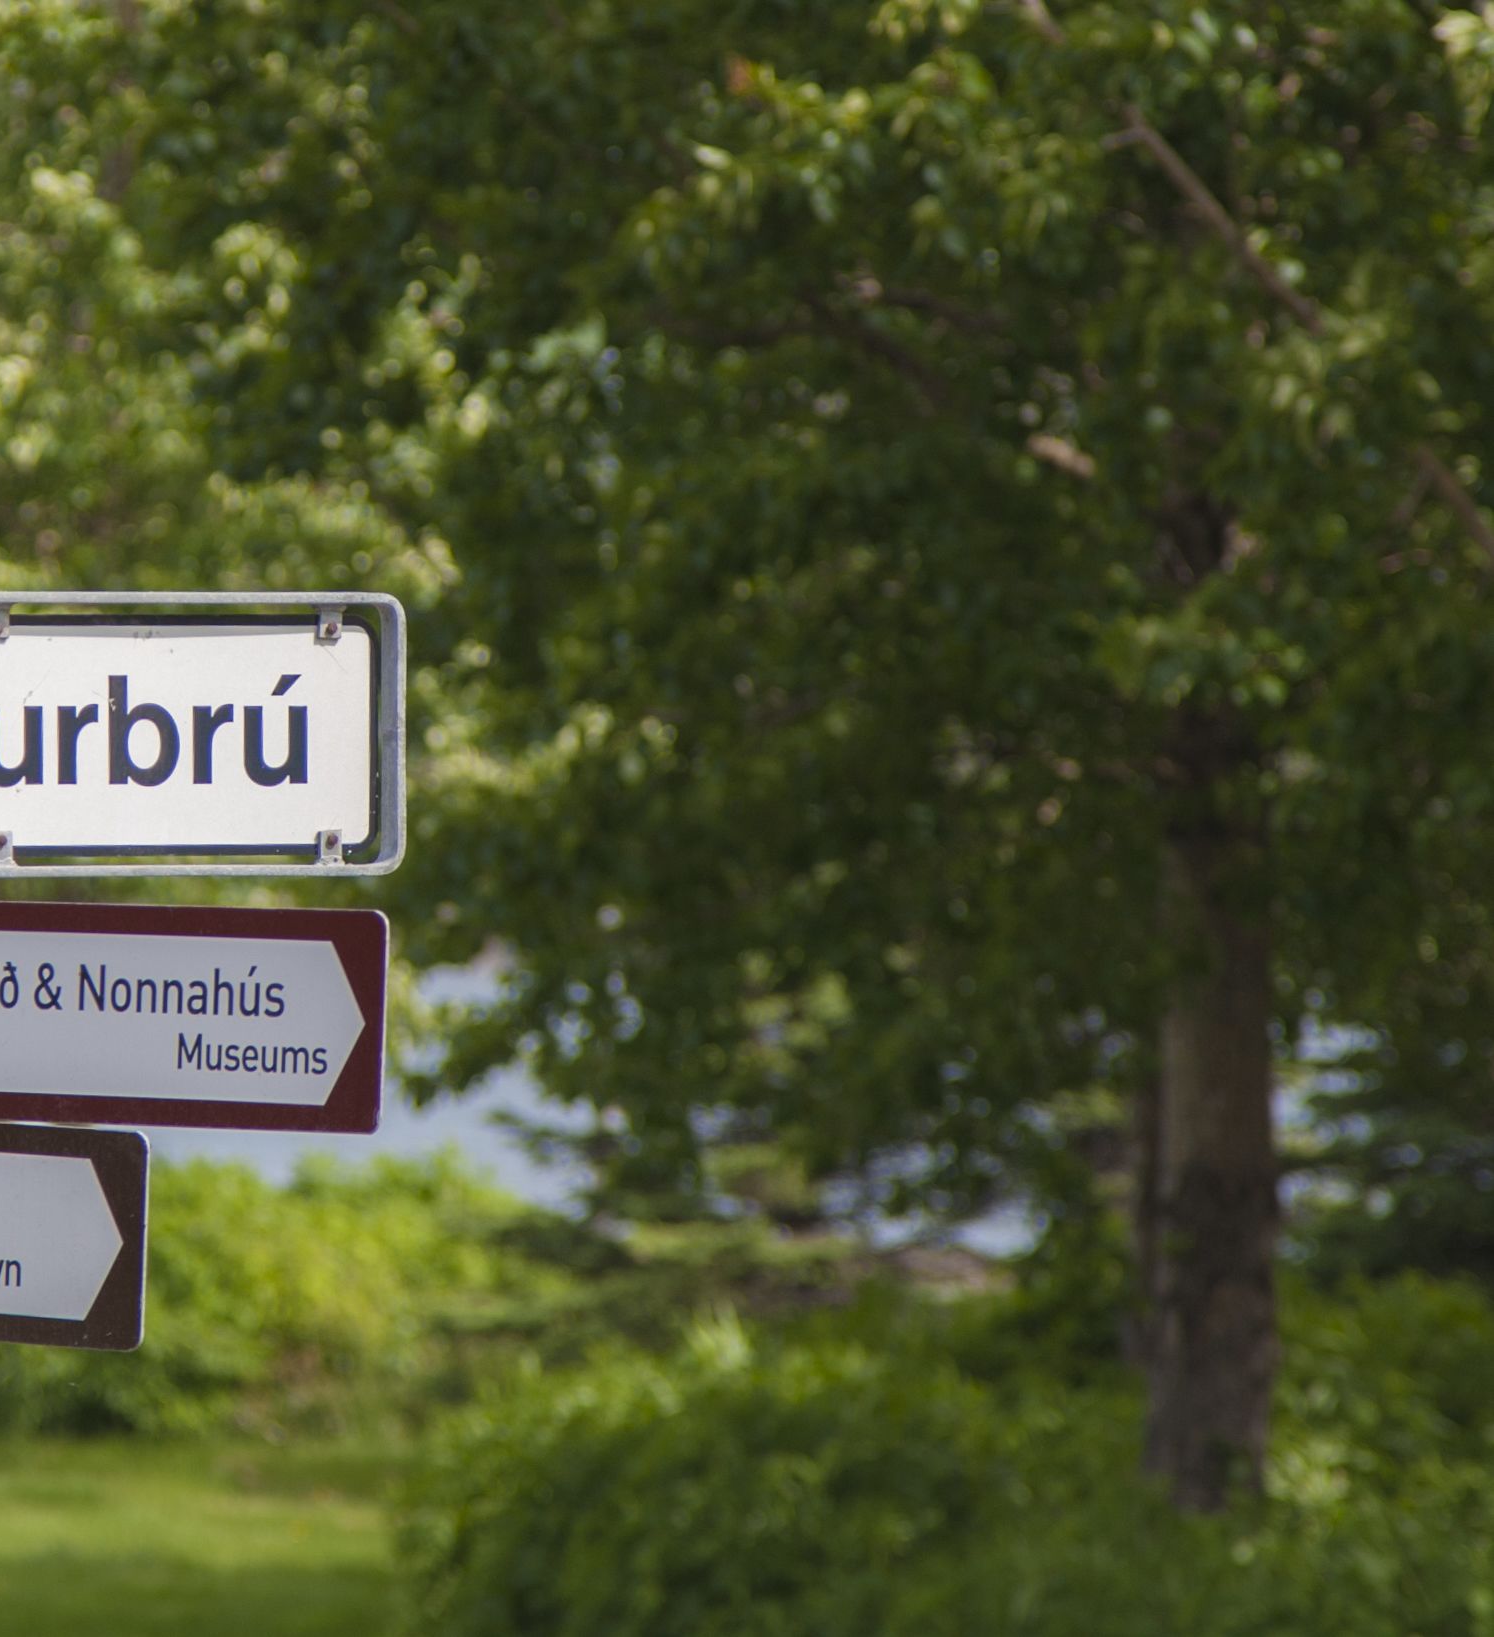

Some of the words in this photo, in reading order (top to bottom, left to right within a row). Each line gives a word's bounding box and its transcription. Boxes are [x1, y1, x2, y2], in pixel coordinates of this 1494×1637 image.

[33, 962, 63, 1011] &
[78, 963, 285, 1018] Nonnahús
[177, 1032, 328, 1075] Museums
